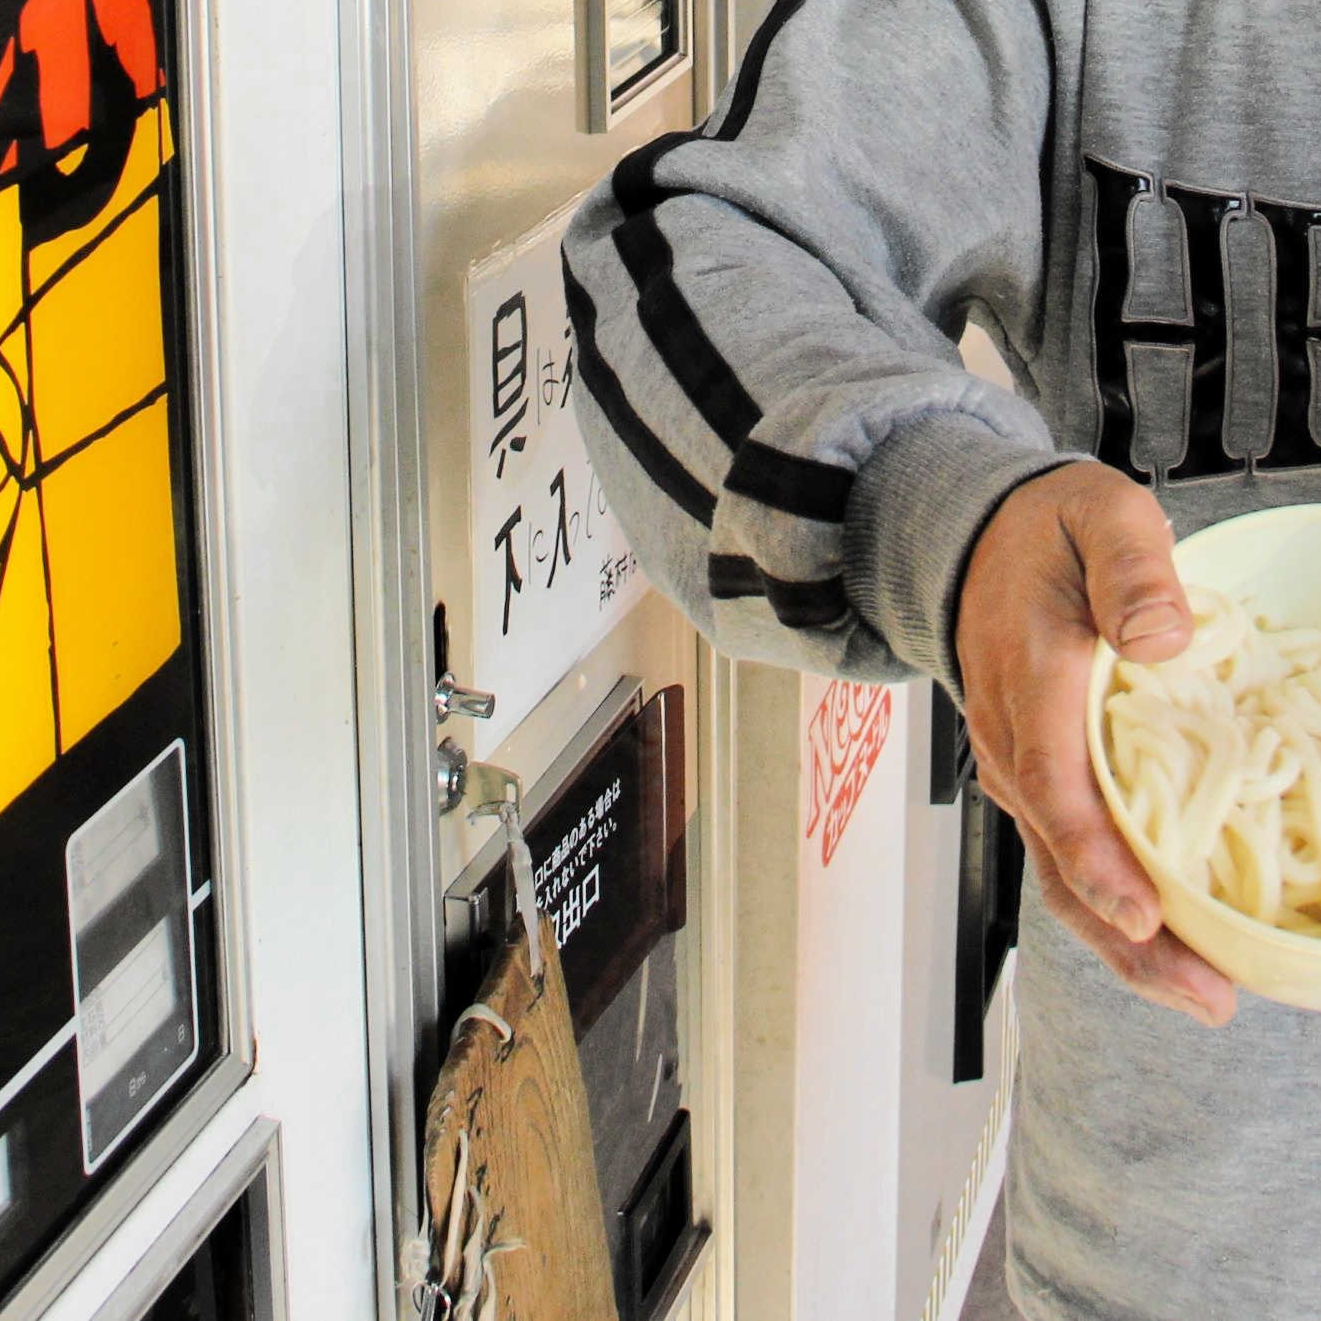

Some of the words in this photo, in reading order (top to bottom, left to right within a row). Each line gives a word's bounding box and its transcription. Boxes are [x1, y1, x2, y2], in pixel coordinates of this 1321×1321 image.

[530, 777, 621, 892] 口に商品のある場合は
